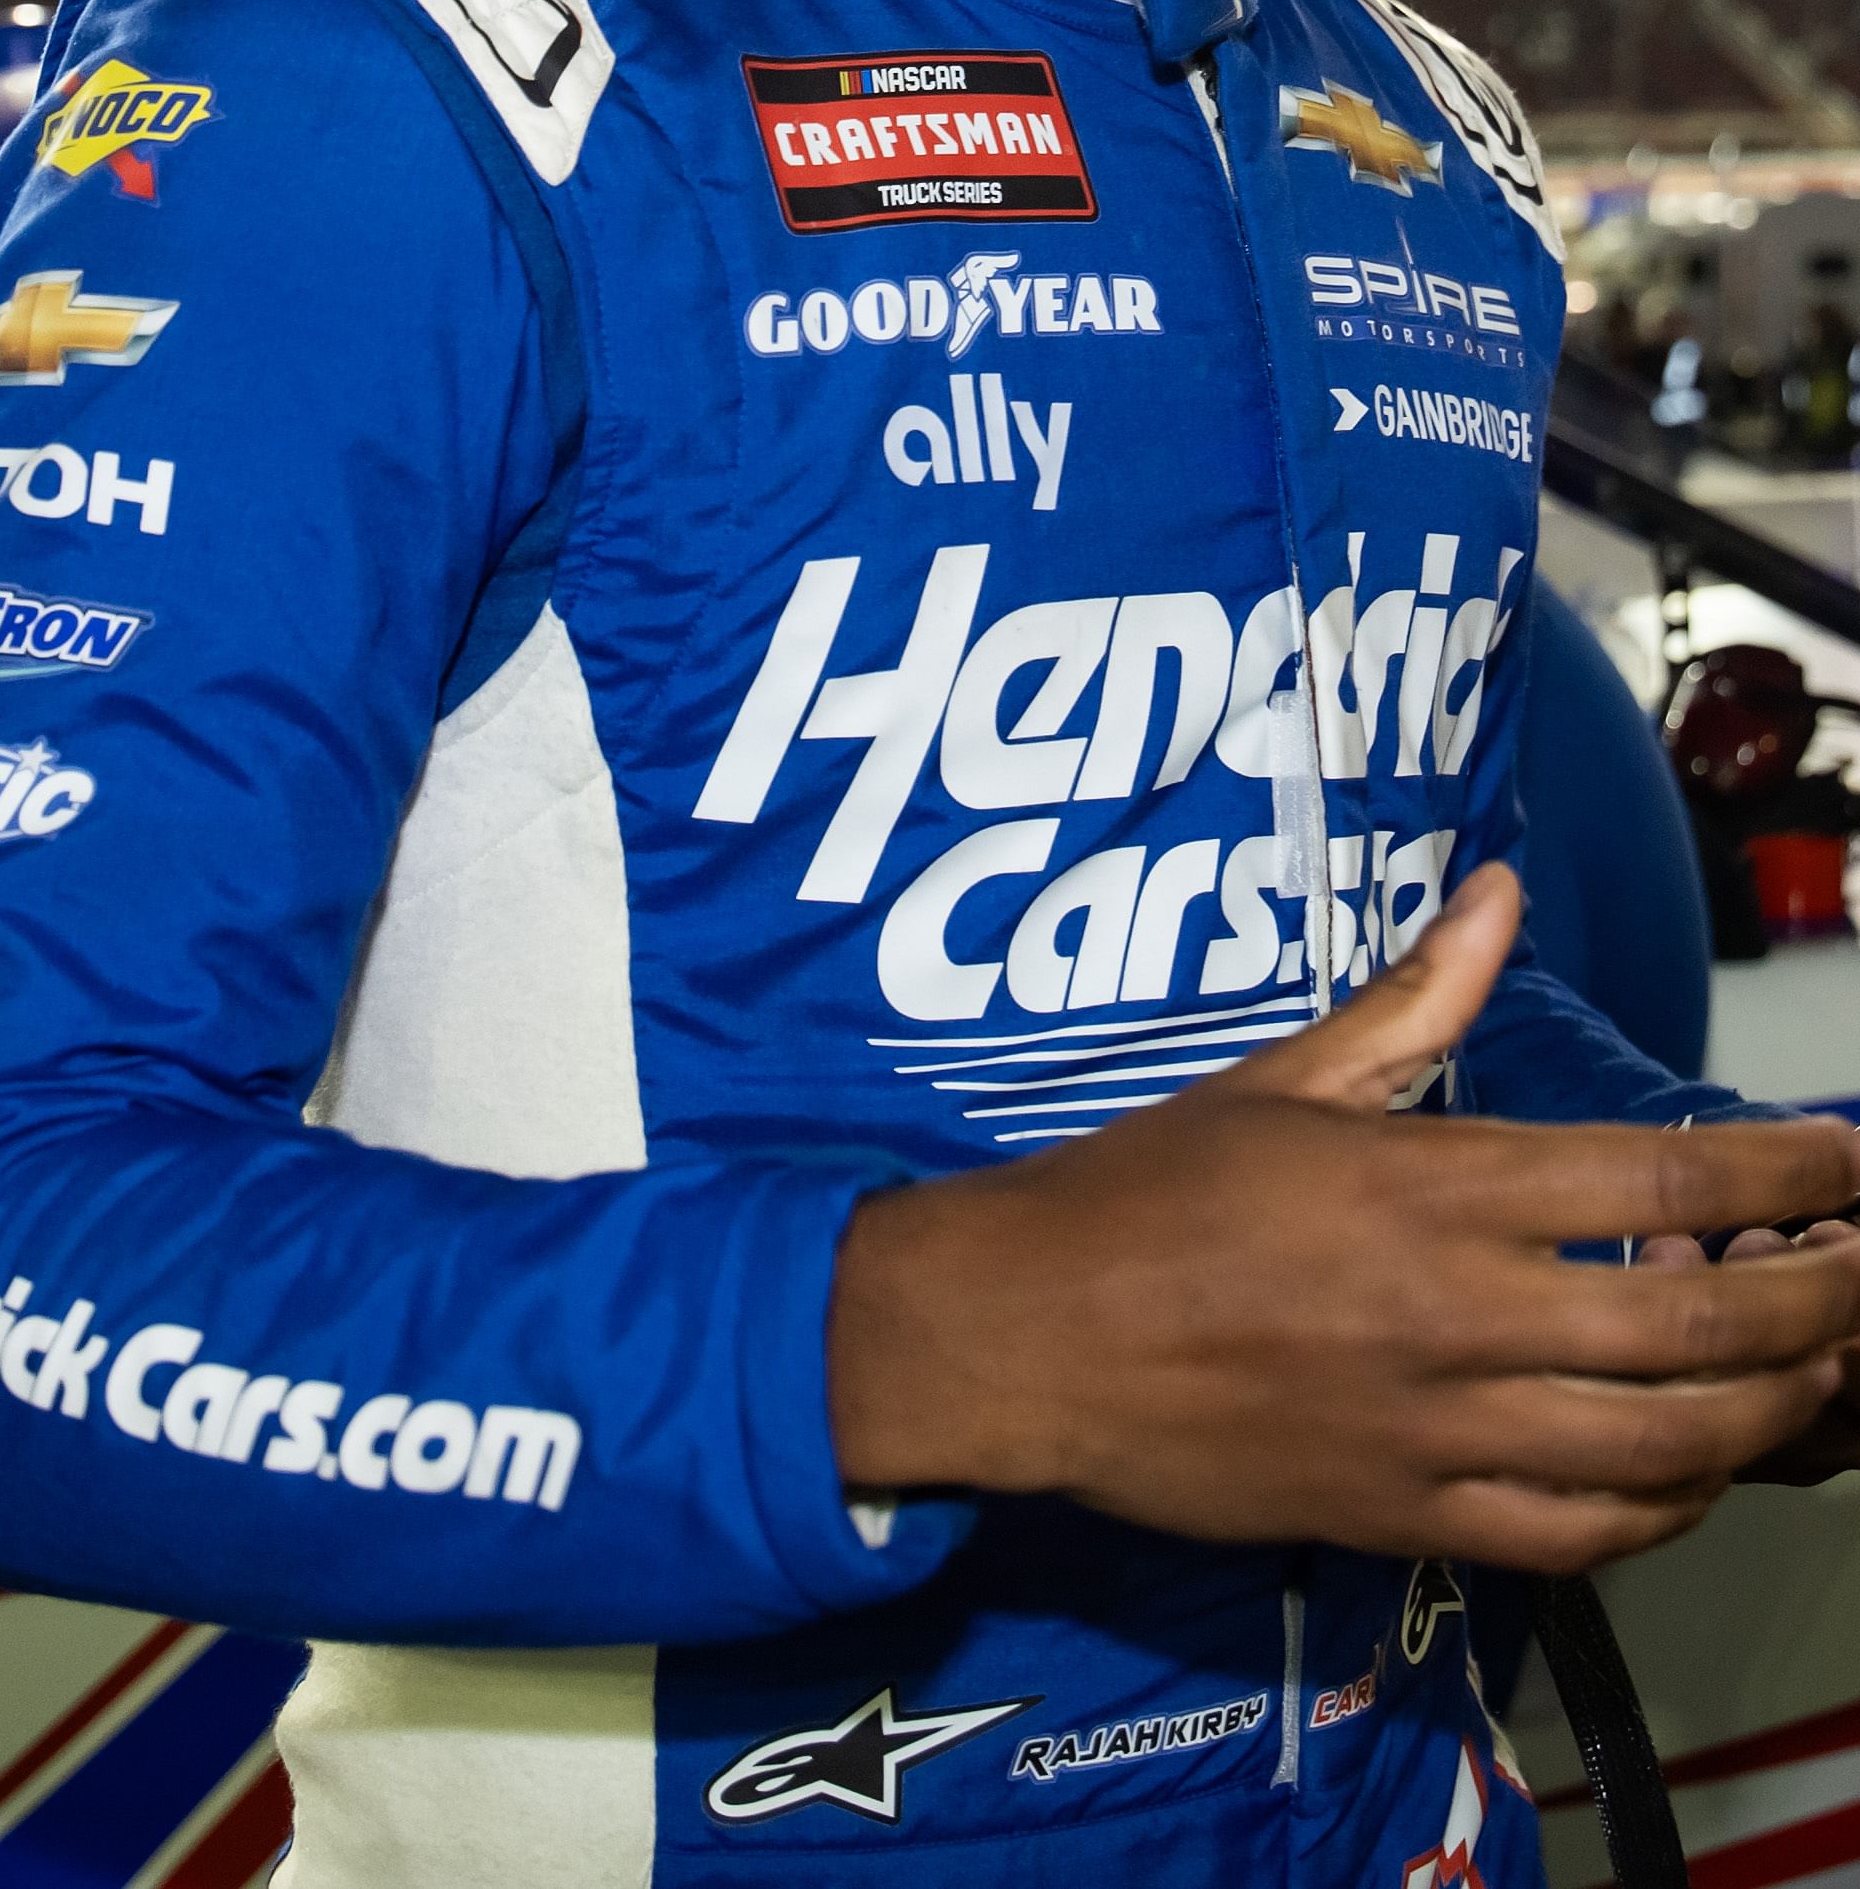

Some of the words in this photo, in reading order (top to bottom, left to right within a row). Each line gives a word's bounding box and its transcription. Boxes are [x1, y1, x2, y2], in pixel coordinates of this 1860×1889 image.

[871, 65, 967, 93] NASCAR
[774, 112, 1062, 166] CRAFTSMAN
[878, 185, 941, 206] TRUCK
[943, 182, 1002, 204] SERIES
[1305, 236, 1520, 336] SPIRE
[883, 373, 1072, 510] ally
[1374, 384, 1532, 463] GAINBRIDGE
[105, 1322, 582, 1511] Cars.com
[1013, 1715, 1166, 1779] RAJAH
[1163, 1691, 1268, 1751] KIRBY
